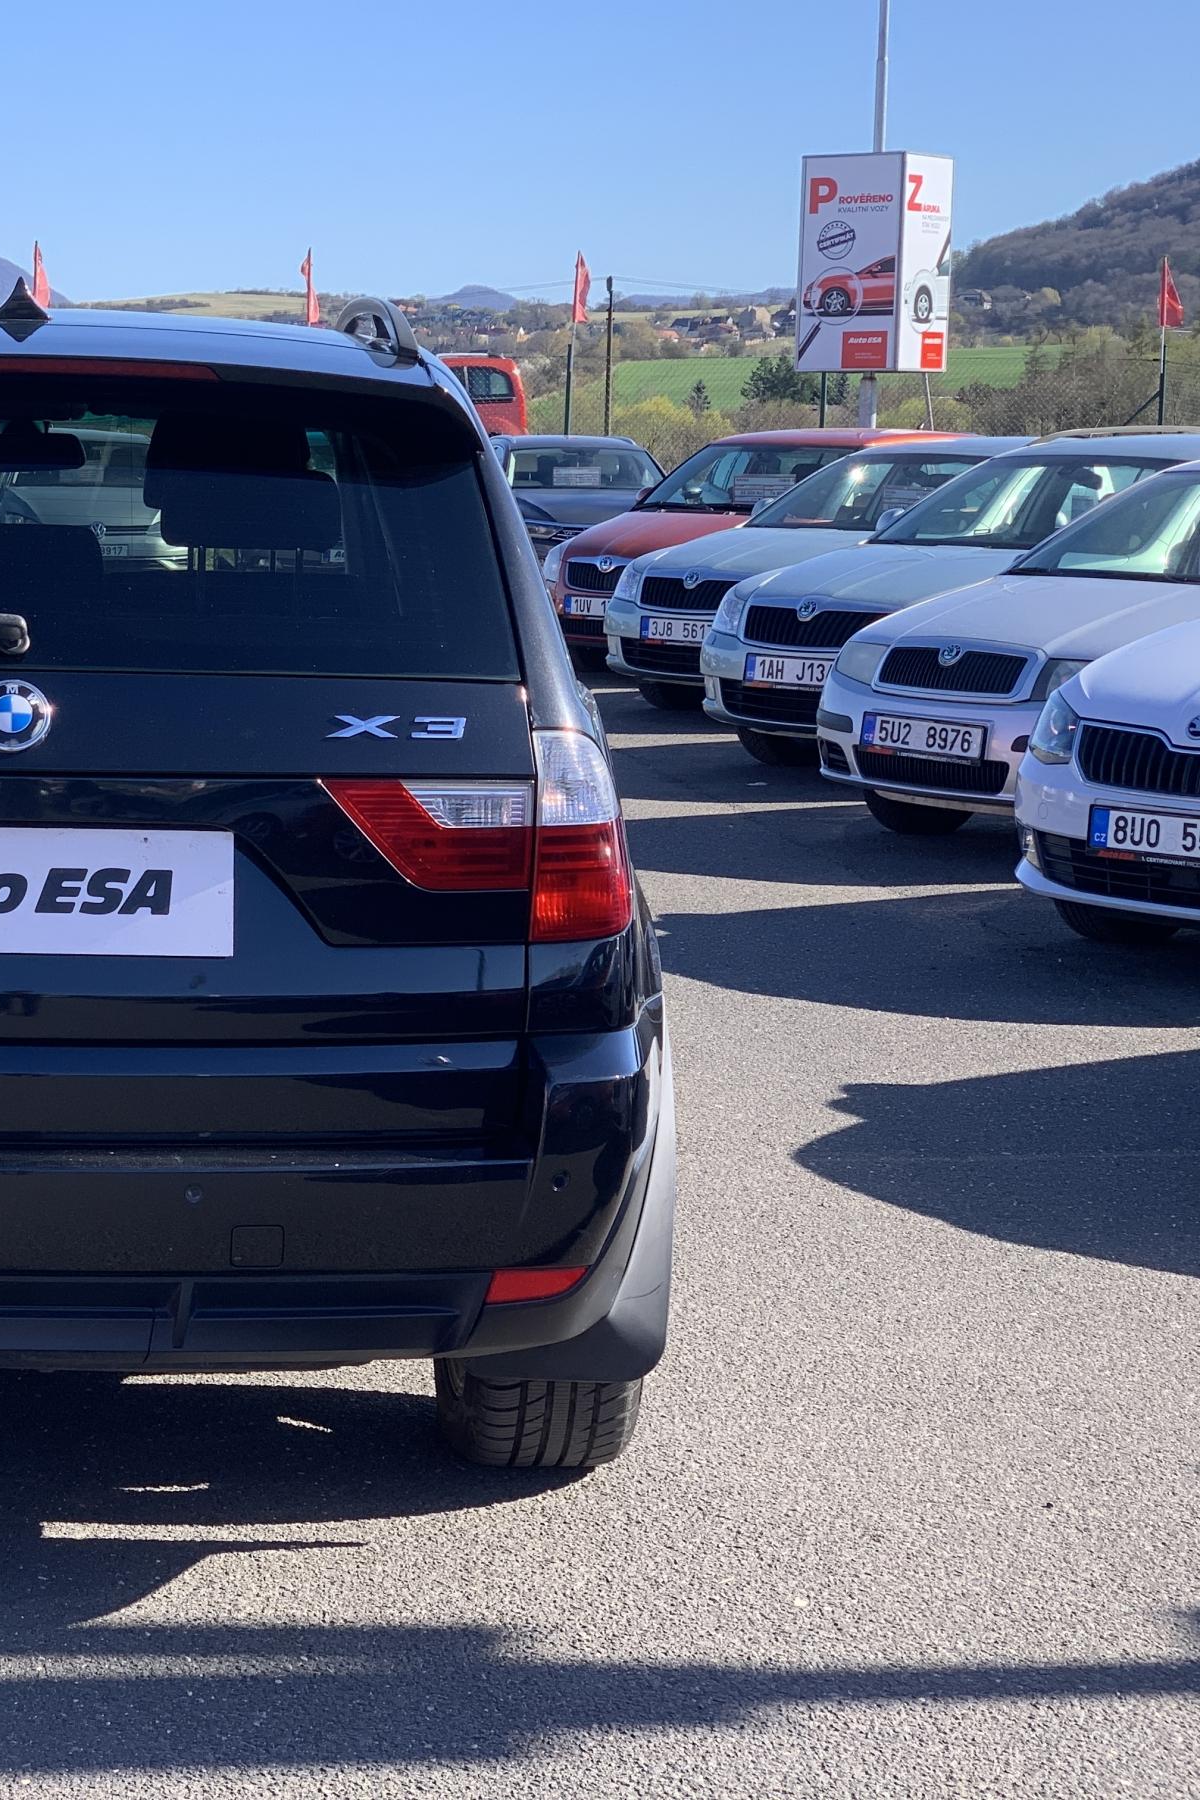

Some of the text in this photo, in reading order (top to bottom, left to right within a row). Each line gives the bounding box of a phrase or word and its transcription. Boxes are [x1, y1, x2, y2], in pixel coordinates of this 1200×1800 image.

[838, 205, 889, 213] KVALITNÍ VOZY
[574, 599, 592, 613] 1UV
[651, 621, 673, 636] 3J8
[760, 659, 784, 680] 1AH
[864, 719, 972, 753] CZ 5U2 8976
[1094, 815, 1200, 852] CZ 8U0 5
[34, 867, 173, 915] ESA
